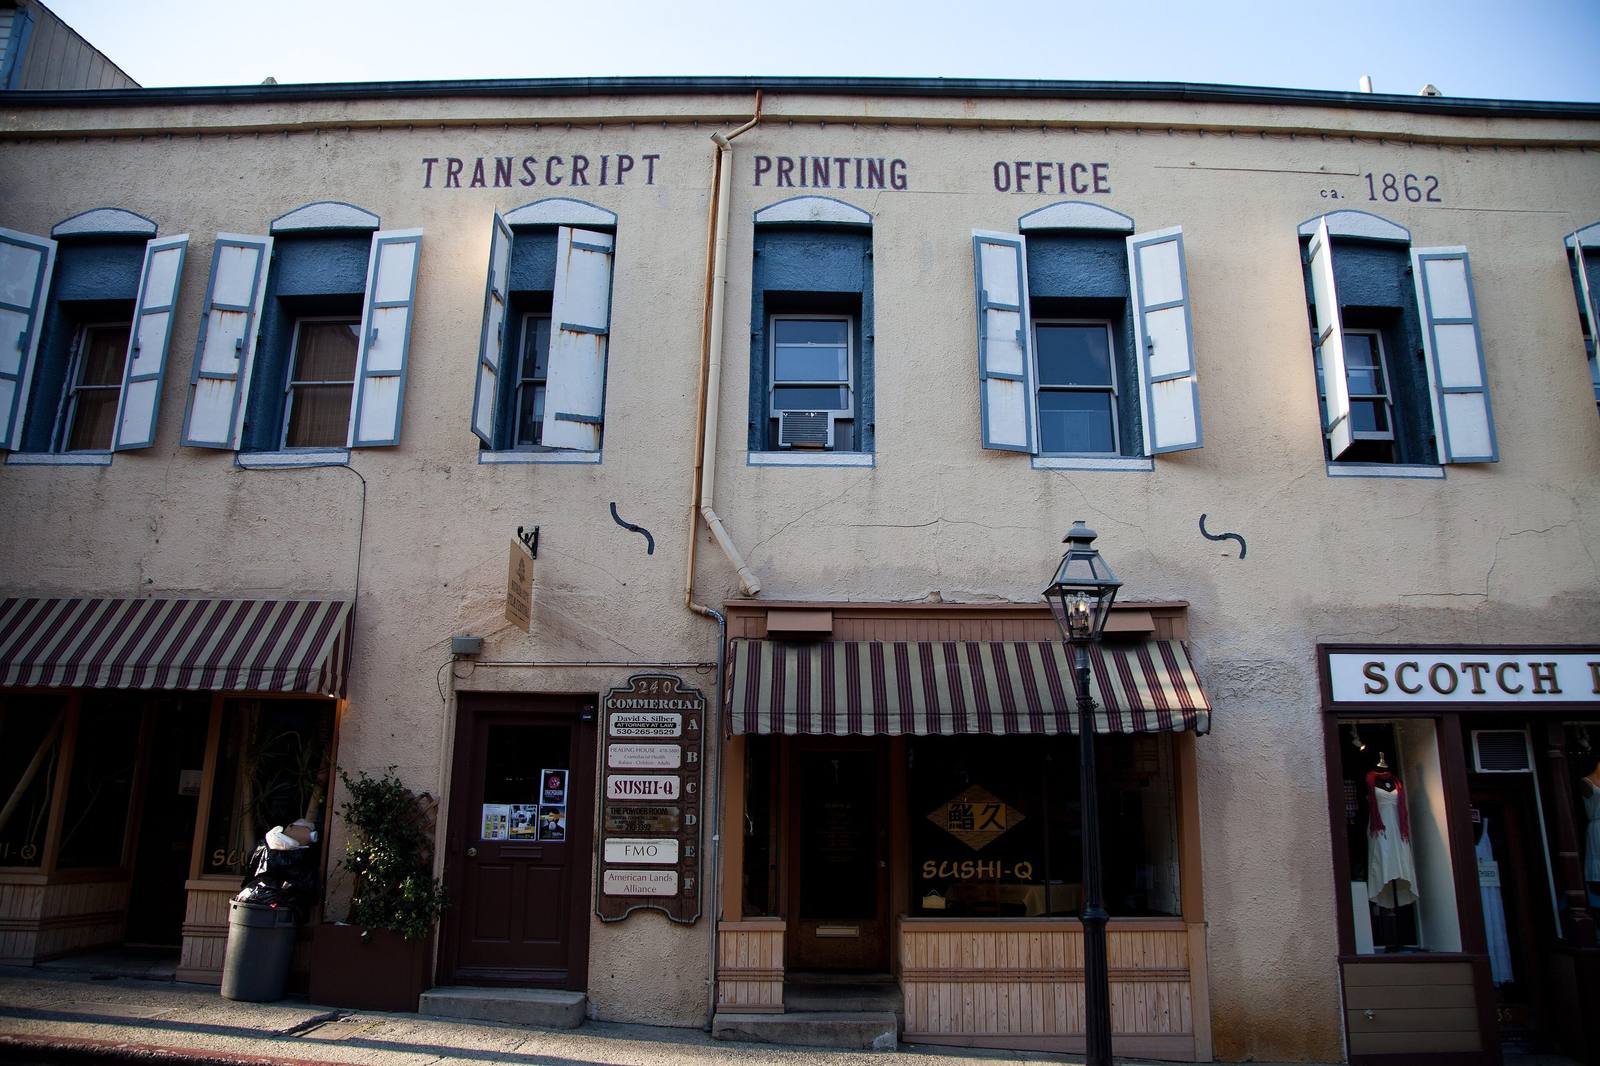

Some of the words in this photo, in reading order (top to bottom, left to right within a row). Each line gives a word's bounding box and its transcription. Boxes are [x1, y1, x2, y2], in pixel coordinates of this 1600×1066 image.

[422, 153, 661, 189] TRANSCRIPT
[753, 154, 909, 190] PRINTING
[993, 160, 1111, 194] OFFICE
[1320, 187, 1345, 199] ca.
[1364, 172, 1442, 203] 1862
[1362, 661, 1563, 695] SCOTCH
[638, 680, 672, 694] 240
[607, 698, 702, 710] COMMERCIAL
[687, 718, 699, 730] A
[686, 751, 698, 763] B
[614, 780, 674, 795] SUSHI-Q
[686, 782, 697, 794] C
[610, 807, 622, 815] THE
[684, 814, 697, 825] D
[625, 845, 658, 857] FMO
[684, 845, 696, 857] E
[922, 860, 1033, 880] SUSHI-Q
[608, 873, 647, 882] American
[649, 873, 673, 882] Lands
[684, 877, 695, 889] F
[624, 884, 657, 893] Alliance
